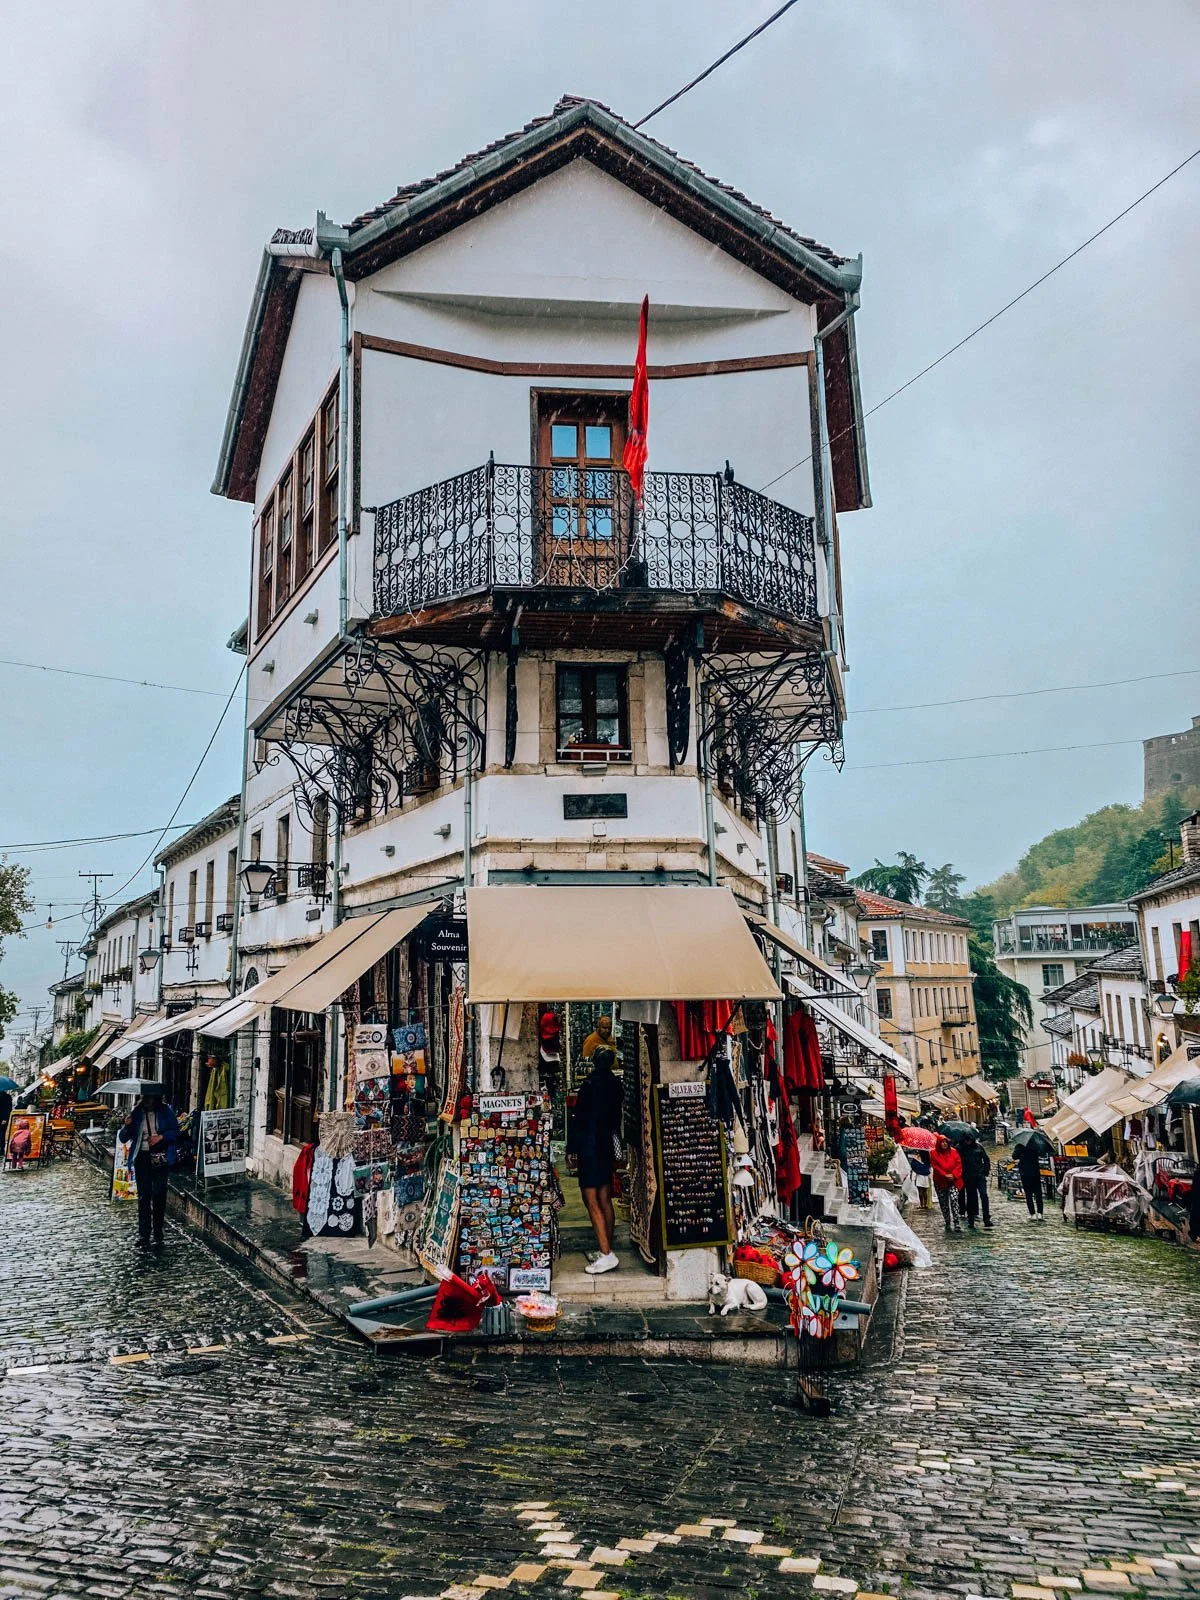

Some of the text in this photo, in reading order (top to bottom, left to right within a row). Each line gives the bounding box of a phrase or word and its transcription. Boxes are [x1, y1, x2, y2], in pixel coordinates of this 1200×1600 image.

[438, 929, 460, 938] Alma
[431, 942, 467, 951] Souvenir
[671, 1084, 704, 1095] SILVER 925
[482, 1098, 522, 1109] MAGNETS
